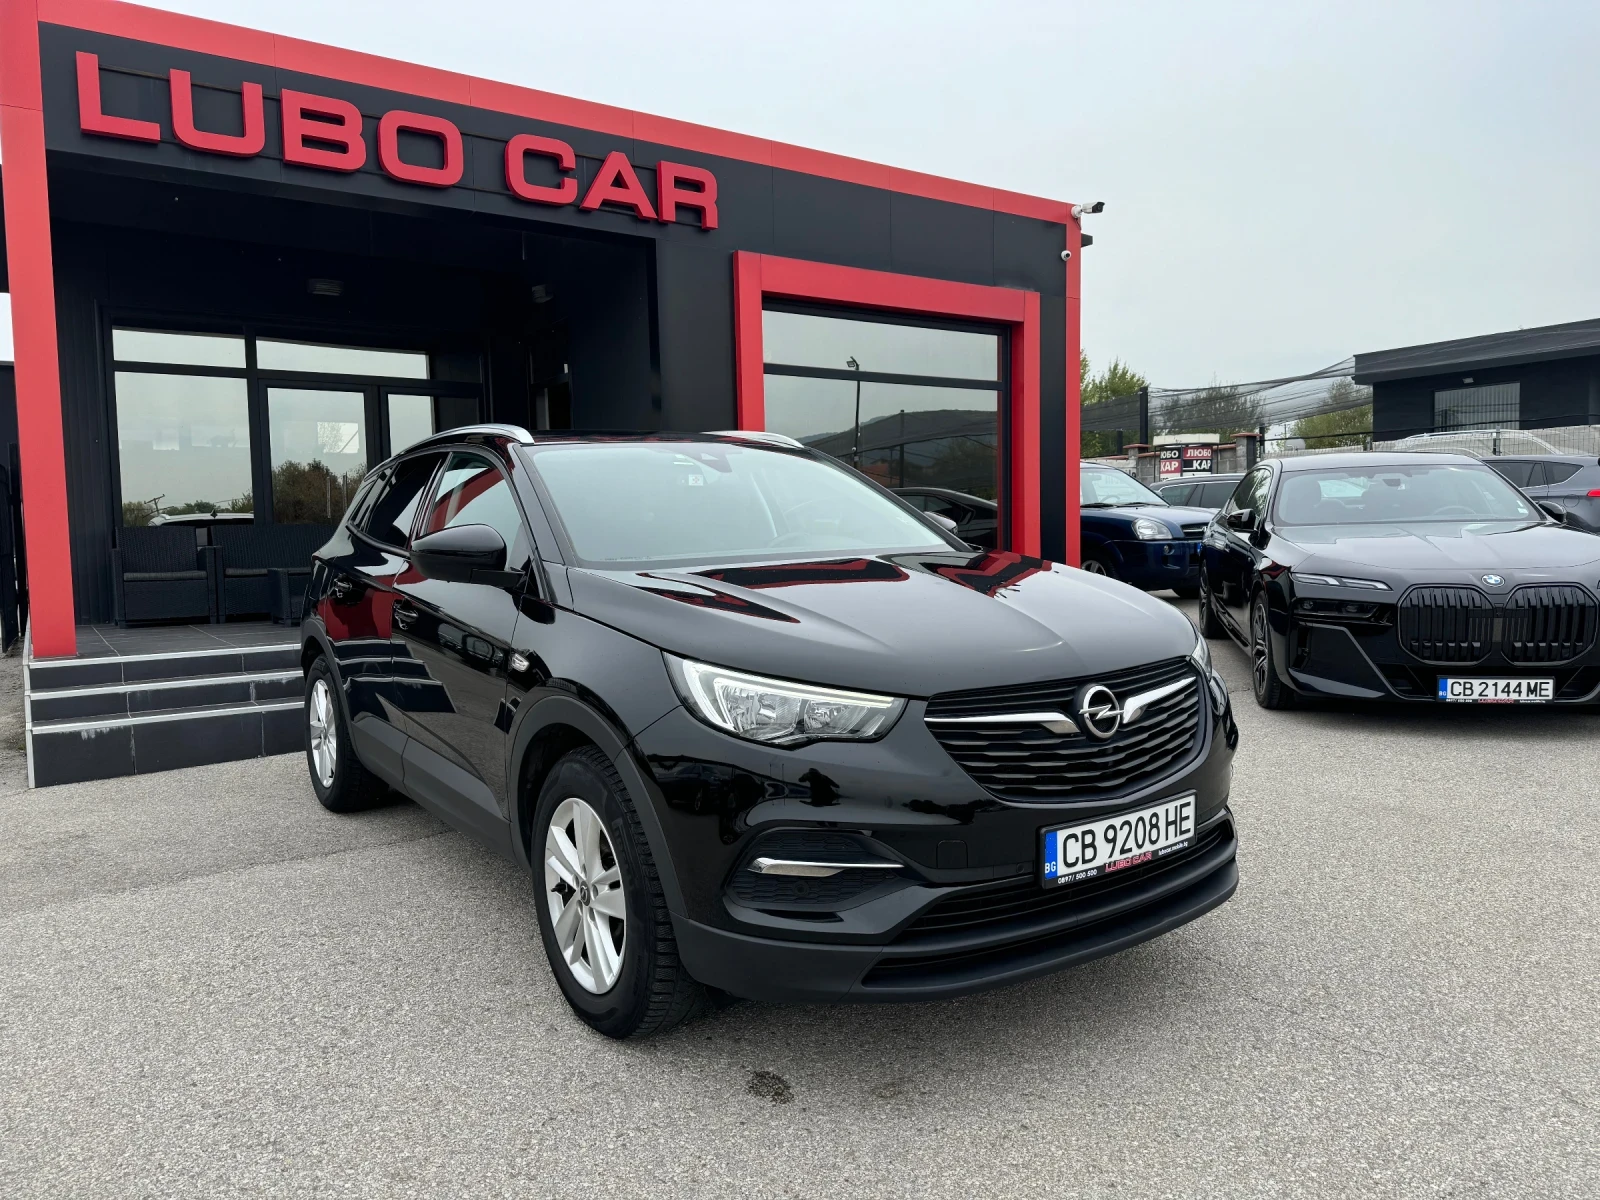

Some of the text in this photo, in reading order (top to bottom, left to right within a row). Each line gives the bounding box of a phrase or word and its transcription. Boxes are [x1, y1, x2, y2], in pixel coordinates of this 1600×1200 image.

[75, 50, 719, 230] LUBO CAR
[1186, 449, 1212, 457] ЛЮБО
[1450, 681, 1550, 697] CB 2144 ME
[1062, 801, 1191, 868] CB 9208 HE
[1044, 862, 1057, 874] BG
[1105, 851, 1152, 872] LUBO CAR
[1076, 872, 1086, 880] 500
[1087, 868, 1098, 877] 500
